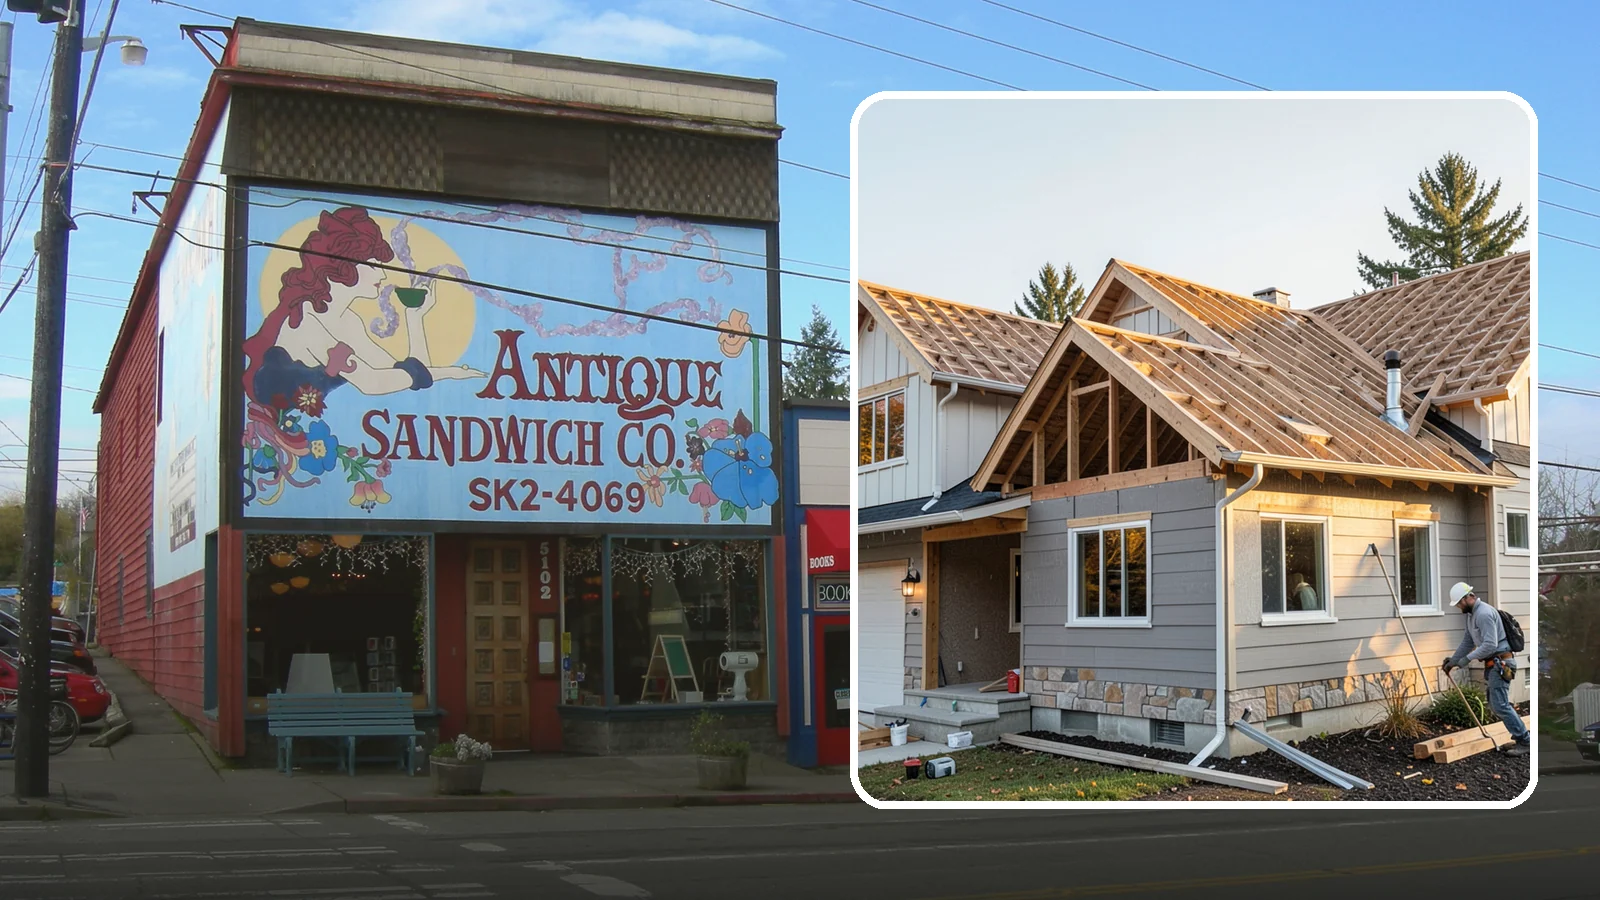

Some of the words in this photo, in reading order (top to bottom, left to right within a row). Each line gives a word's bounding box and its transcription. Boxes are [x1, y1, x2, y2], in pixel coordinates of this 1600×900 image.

[475, 329, 724, 421] ANTIQUE
[361, 408, 605, 468] SANDWICH
[617, 421, 685, 469] CO.
[468, 476, 646, 513] SK2-4069
[539, 541, 552, 600] 5102
[809, 555, 835, 569] BOOKS
